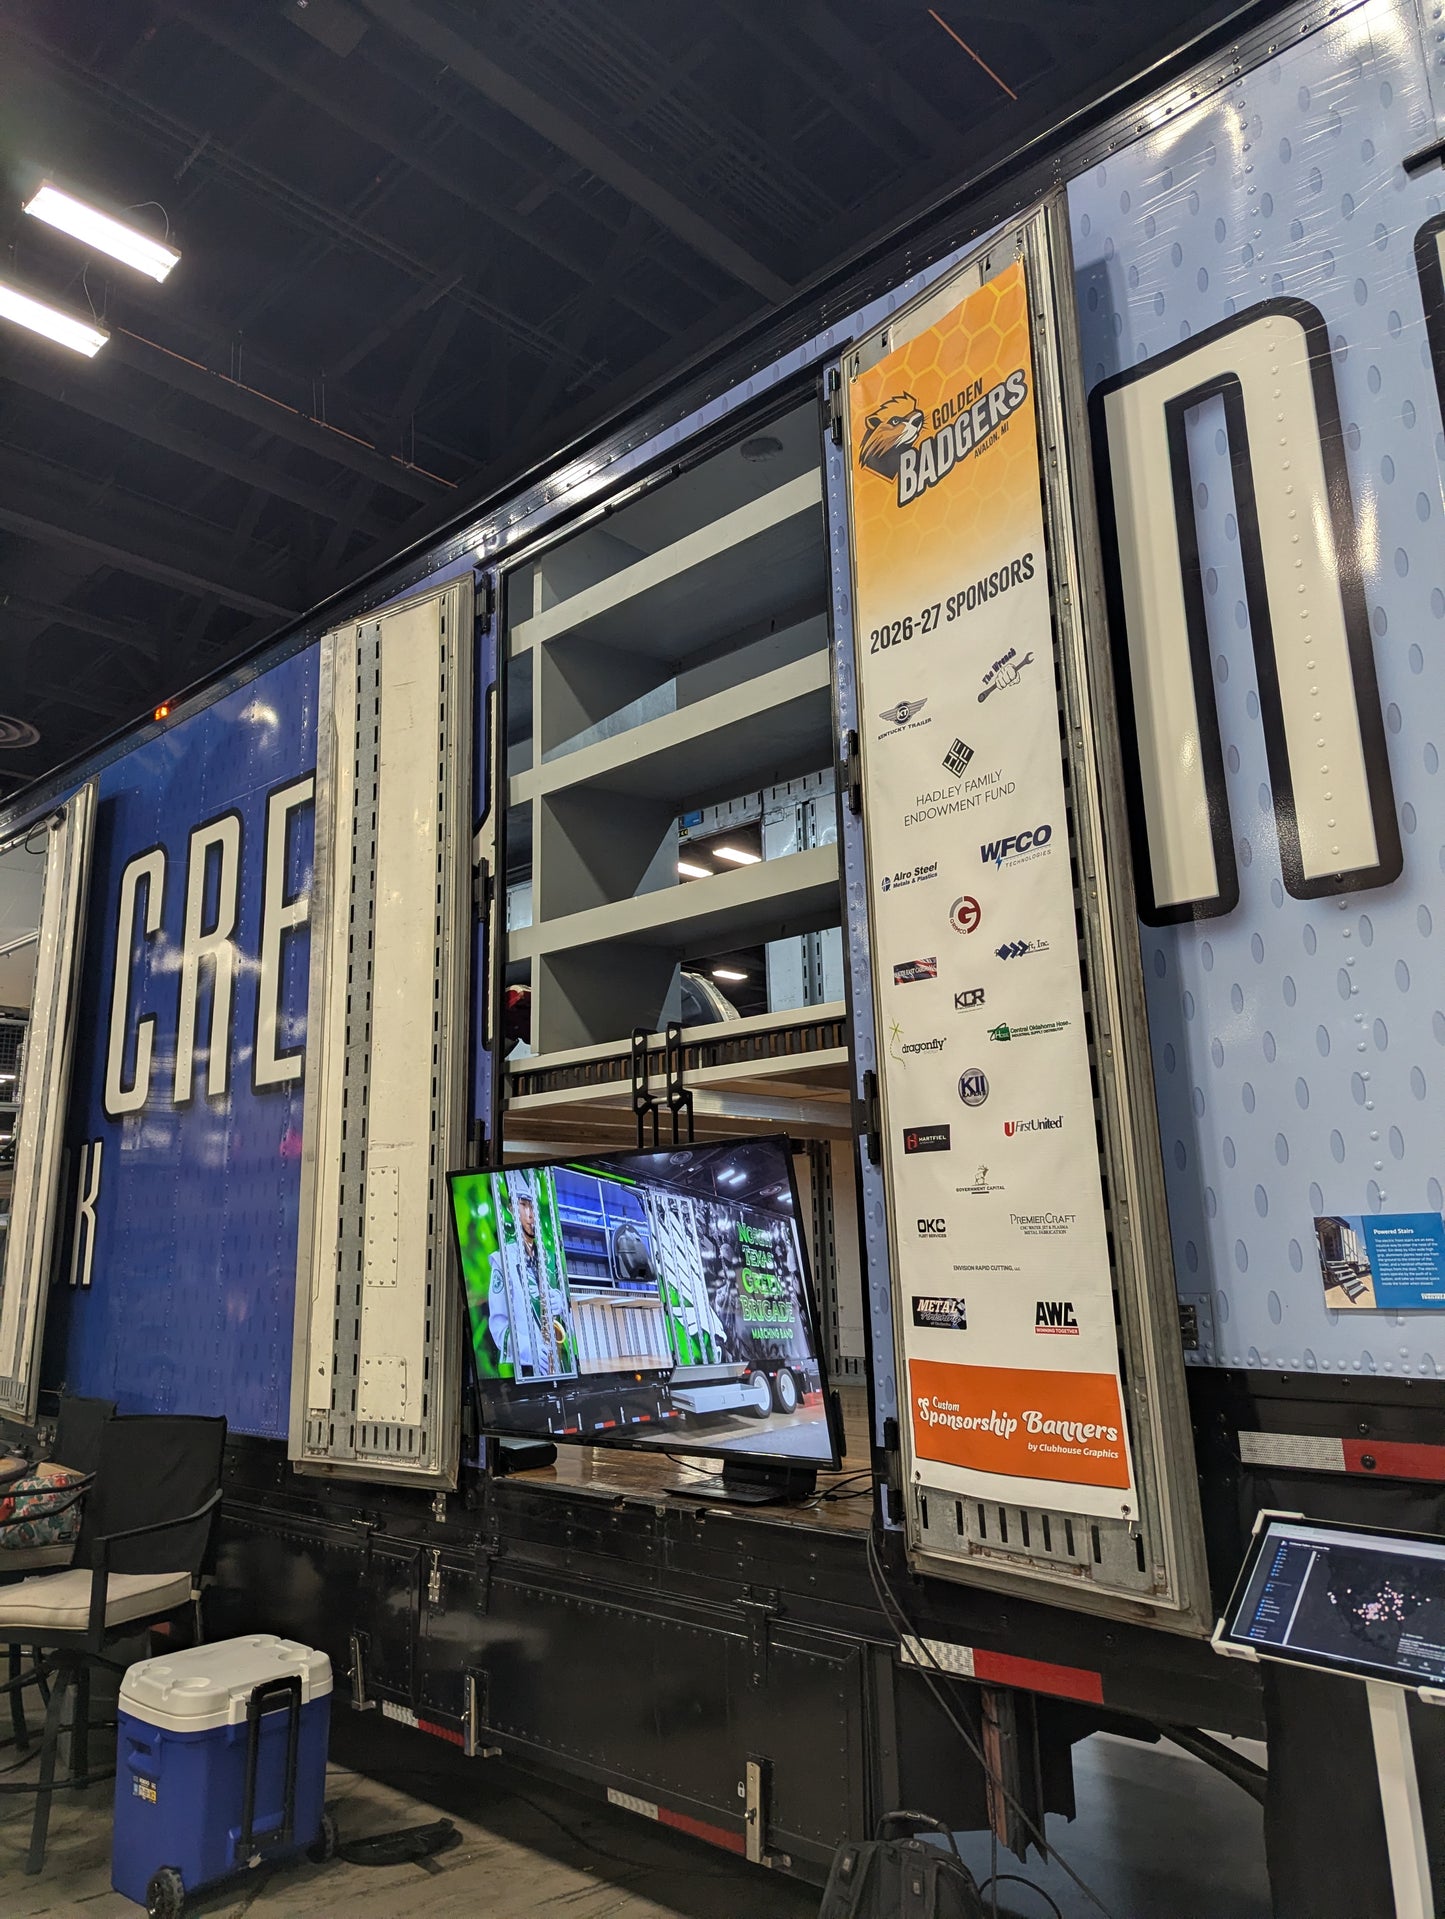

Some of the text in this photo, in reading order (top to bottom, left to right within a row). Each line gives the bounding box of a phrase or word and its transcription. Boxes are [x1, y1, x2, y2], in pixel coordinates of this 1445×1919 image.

[931, 376, 984, 430] GOLDEN
[898, 367, 1029, 509] BADGERS
[1000, 421, 1010, 436] MI
[870, 552, 1035, 655] 2026-27 SPONSORS
[992, 647, 1016, 672] Wrench
[908, 717, 932, 729] TRAILER
[916, 769, 1003, 807] HADLEY FAMILY
[904, 782, 1016, 827] ENDOWMENT FUND
[980, 824, 1052, 863] WFCO
[914, 861, 938, 877] Steel
[1005, 849, 1052, 868] TECHNOLOGIES
[917, 1218, 946, 1233] OKC
[740, 1295, 796, 1323] BRIGADE
[917, 1299, 958, 1314] METAL
[1036, 1301, 1078, 1326] AWC
[932, 1396, 960, 1412] Custom
[918, 1397, 1118, 1444] Sponsorship Banners
[1028, 1442, 1119, 1459] by Clubhouse Graphics
